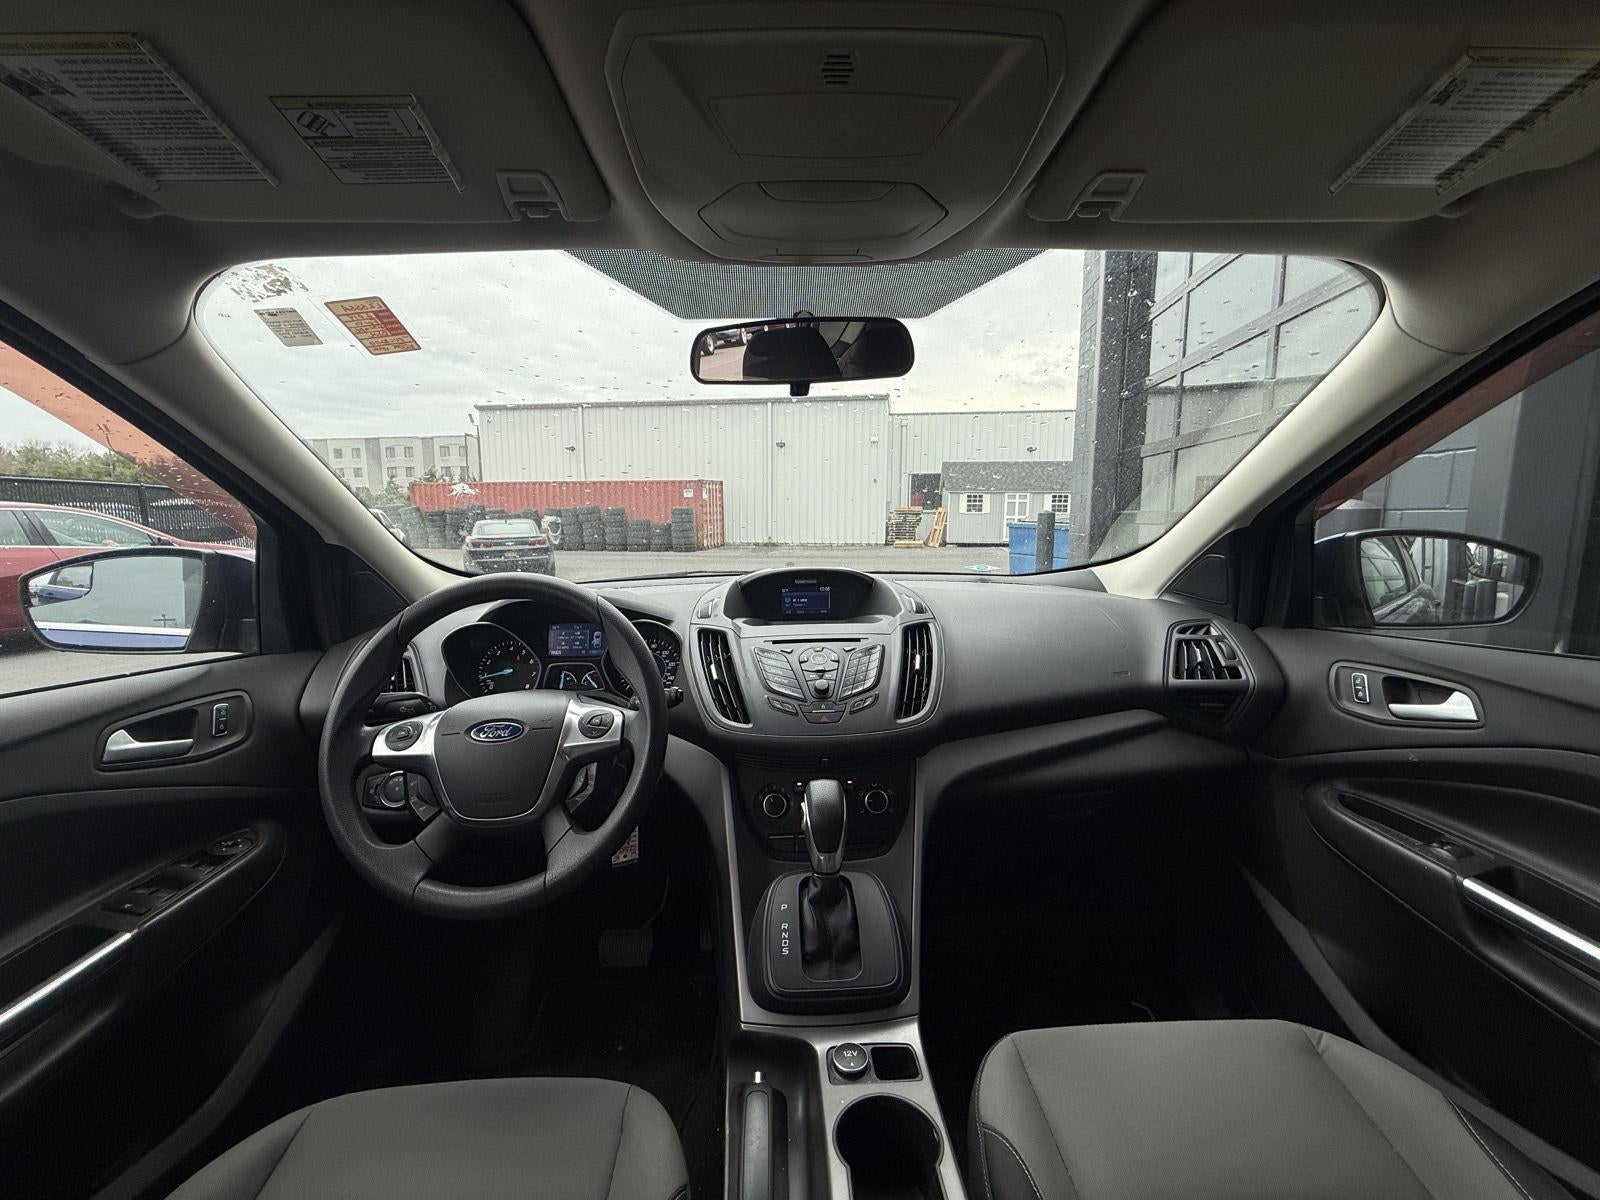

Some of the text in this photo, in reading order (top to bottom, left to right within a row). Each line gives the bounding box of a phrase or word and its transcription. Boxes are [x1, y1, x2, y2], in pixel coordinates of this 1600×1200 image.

[479, 724, 513, 738] Ford
[781, 931, 789, 939] N
[781, 939, 789, 947] D
[781, 947, 789, 955] S
